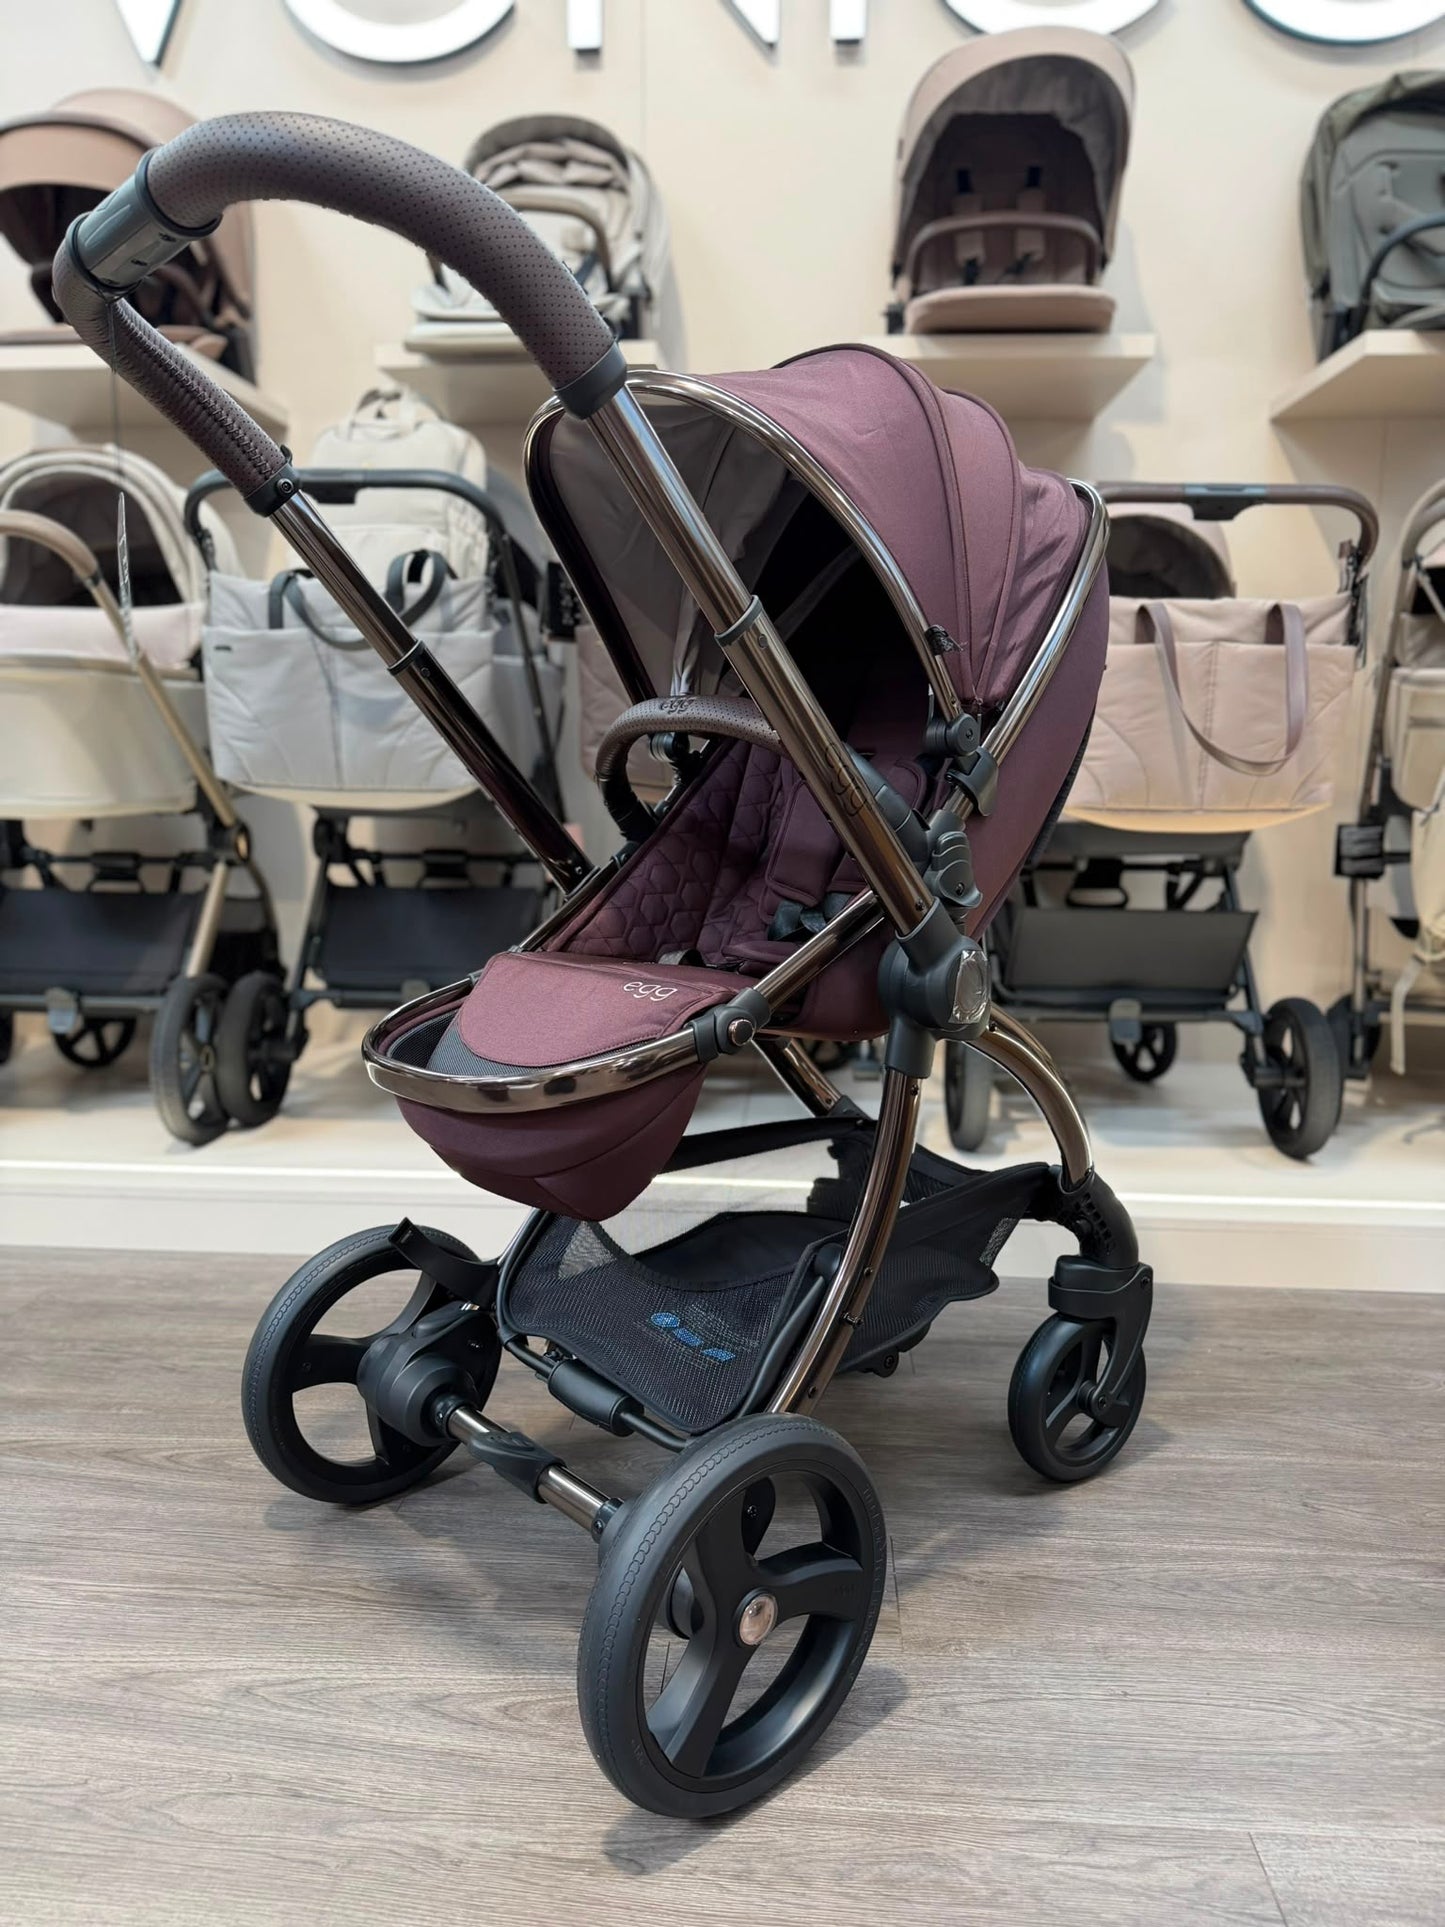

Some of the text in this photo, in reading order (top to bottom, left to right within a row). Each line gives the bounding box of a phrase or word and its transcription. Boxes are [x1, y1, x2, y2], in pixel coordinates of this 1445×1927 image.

[659, 697, 696, 714] egg
[824, 744, 867, 817] egg
[623, 981, 678, 1002] egg
